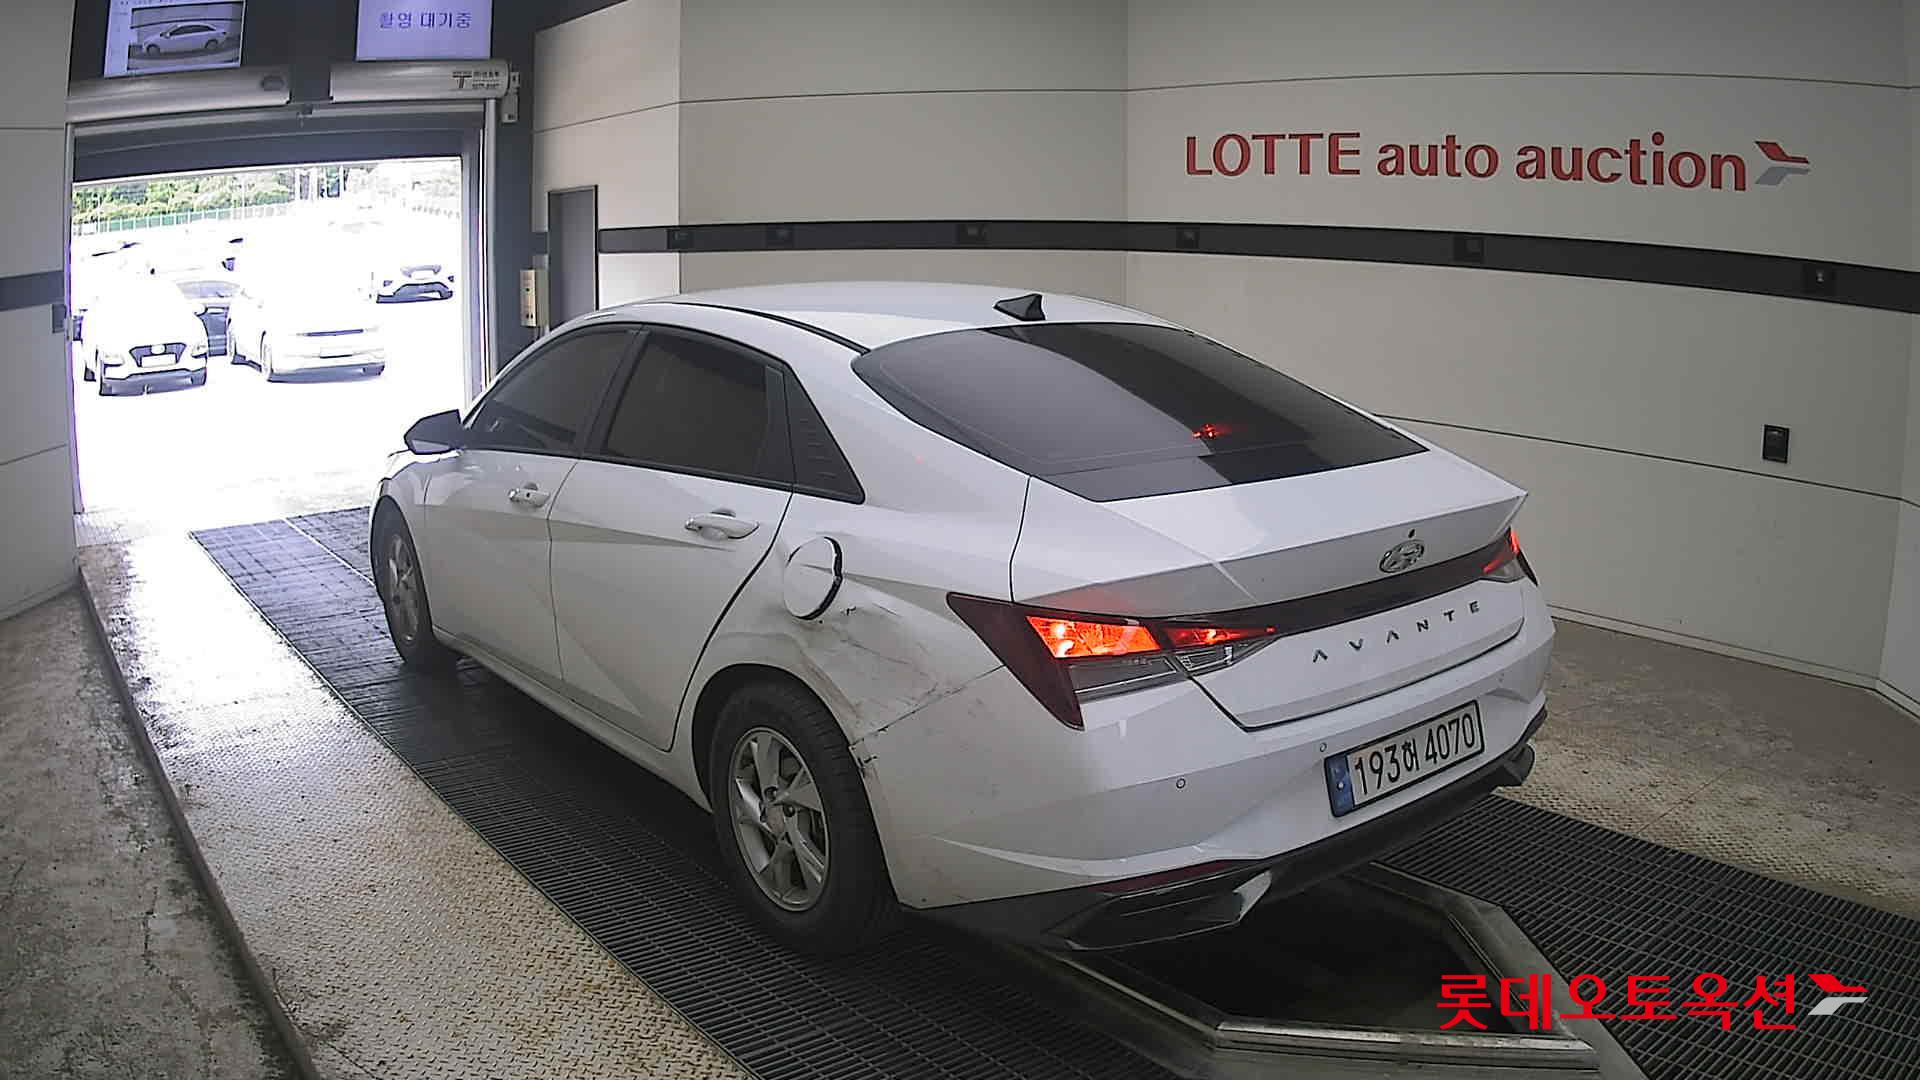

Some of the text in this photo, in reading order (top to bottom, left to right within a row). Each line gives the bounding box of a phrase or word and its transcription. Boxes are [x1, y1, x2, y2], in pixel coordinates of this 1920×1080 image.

[420, 12, 471, 29] 대기중
[1186, 131, 1747, 191] LOTTE auto auction
[1312, 600, 1480, 663] AVANTE
[1425, 713, 1476, 765] 4070
